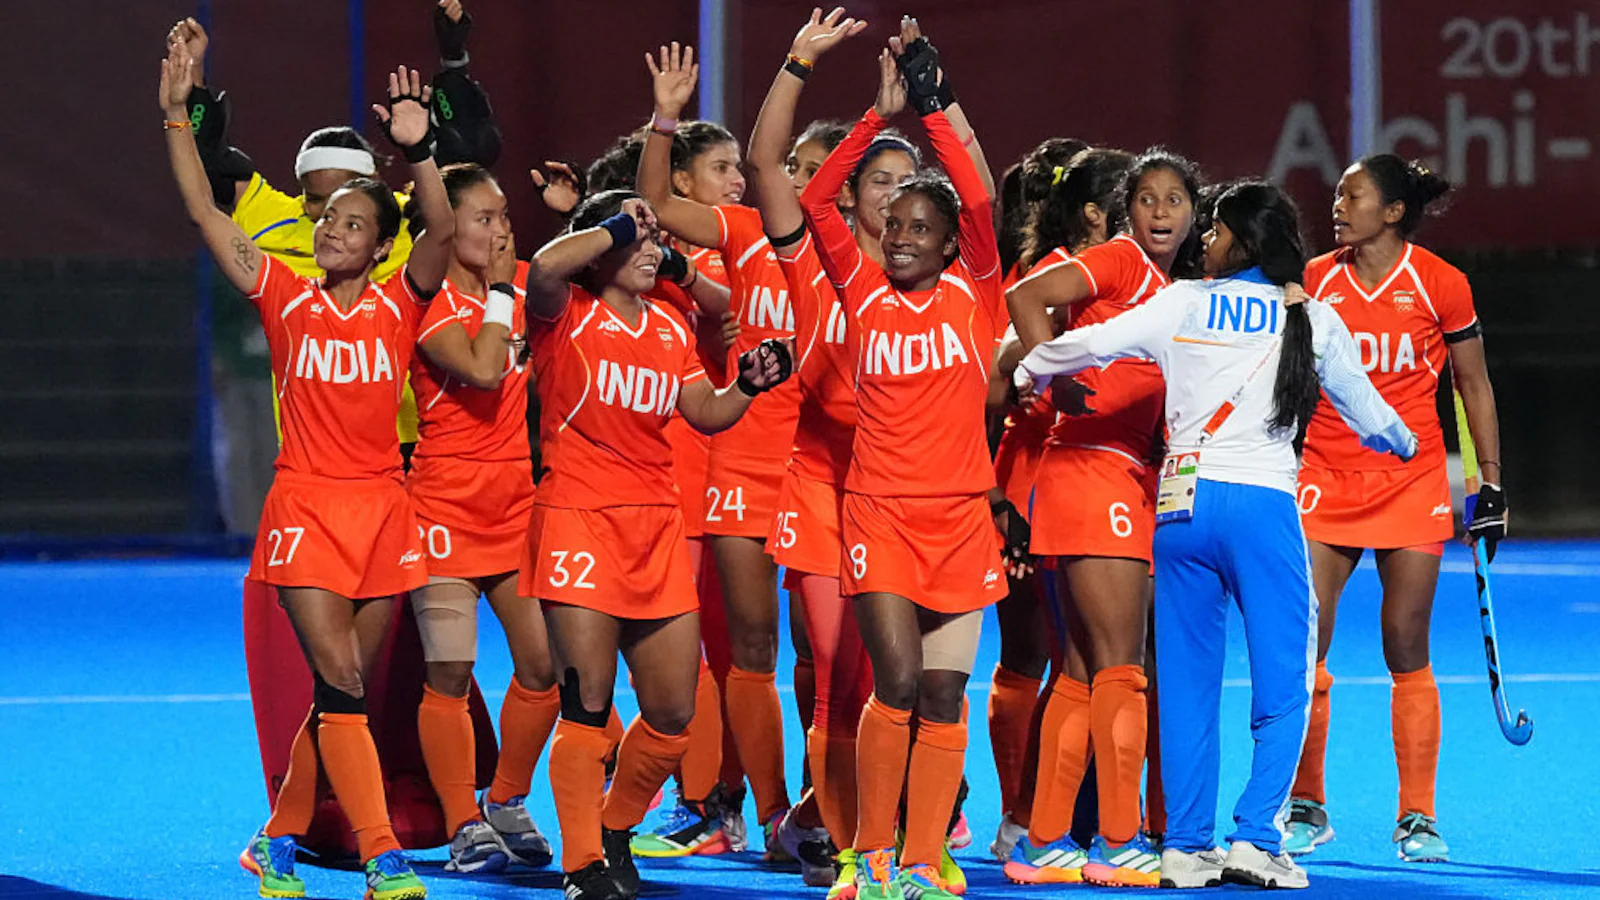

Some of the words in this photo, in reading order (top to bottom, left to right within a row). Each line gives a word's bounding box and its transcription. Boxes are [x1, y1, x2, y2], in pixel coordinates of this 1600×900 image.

[1207, 293, 1279, 335] INDI
[294, 333, 394, 384] INDIA
[866, 322, 969, 376] INDIA
[1354, 331, 1417, 373] DIA
[596, 358, 680, 418] INDIA
[706, 485, 747, 523] 24
[1108, 501, 1133, 539] 6
[1297, 480, 1322, 518] 0
[268, 525, 305, 567] 27
[417, 523, 452, 560] 0
[849, 542, 868, 580] 8
[549, 549, 597, 591] 32
